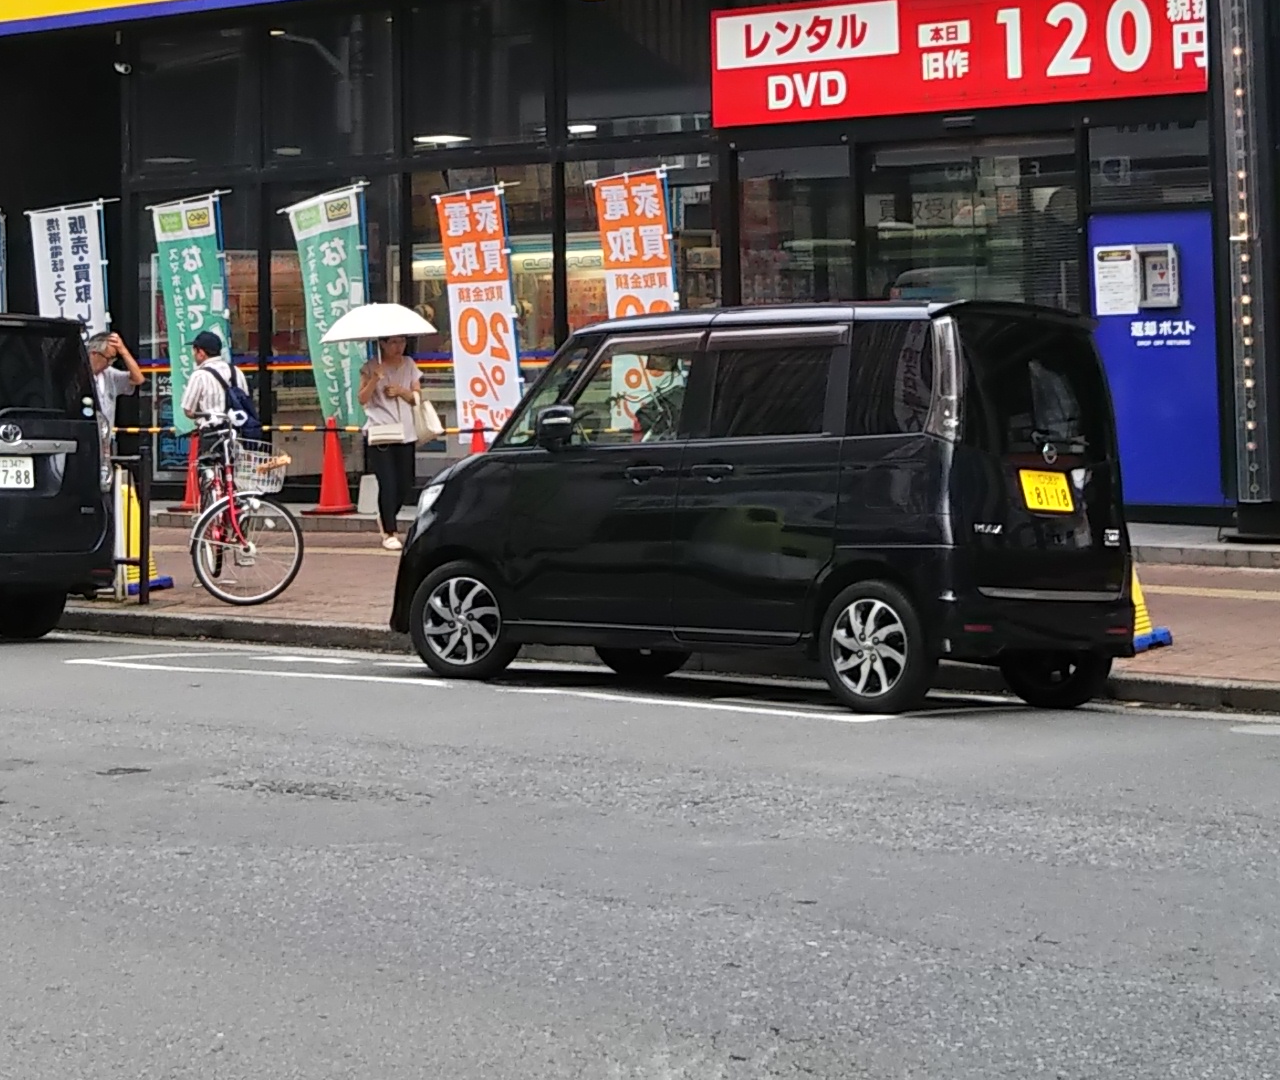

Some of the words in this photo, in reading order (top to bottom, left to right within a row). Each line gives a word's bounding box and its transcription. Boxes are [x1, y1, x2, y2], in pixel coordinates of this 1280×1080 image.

[744, 13, 868, 59] レンタル
[929, 24, 959, 43] 本日
[922, 49, 970, 81] 旧作
[767, 69, 847, 111] DVD
[1034, 486, 1070, 508] 81-18
